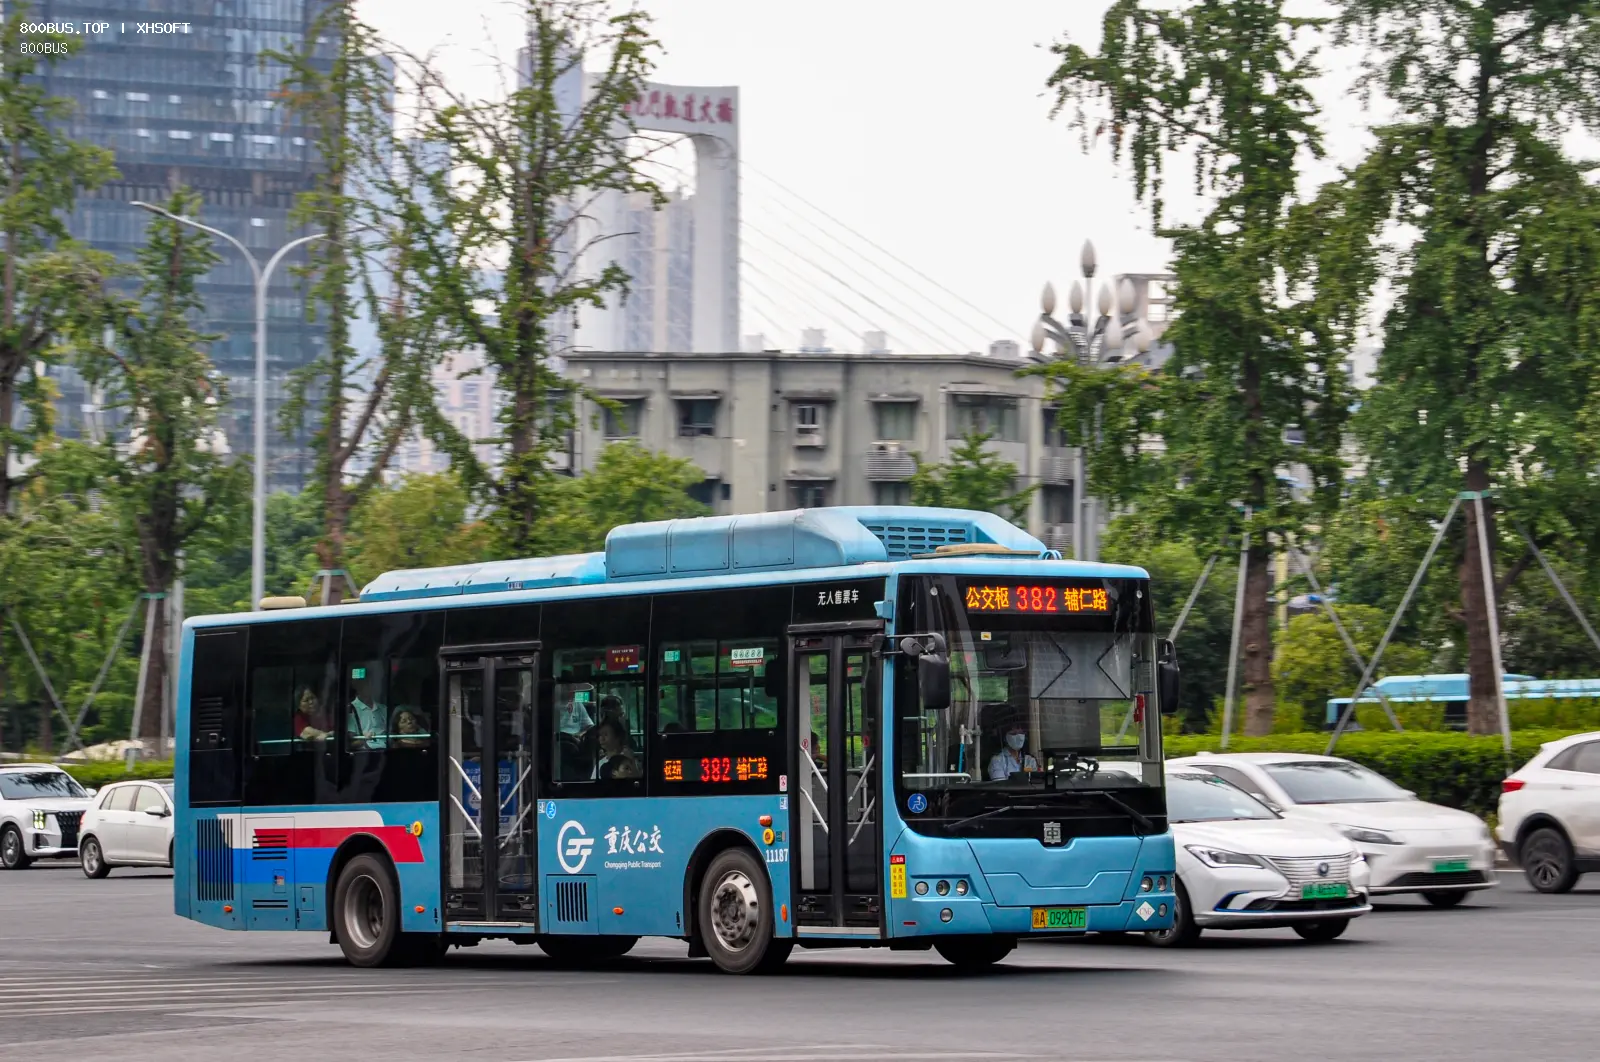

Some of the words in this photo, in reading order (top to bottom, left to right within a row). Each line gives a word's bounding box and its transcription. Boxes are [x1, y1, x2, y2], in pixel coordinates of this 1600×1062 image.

[817, 588, 860, 606] 无人售票车
[965, 585, 1010, 610] 公交枢
[1015, 585, 1058, 611] 382
[1063, 587, 1109, 611] 辅仁路
[700, 757, 731, 782] 382
[603, 825, 665, 855] 重庆公交
[604, 861, 628, 869] Chongqing
[641, 860, 662, 869] Transport
[765, 848, 789, 863] 11187
